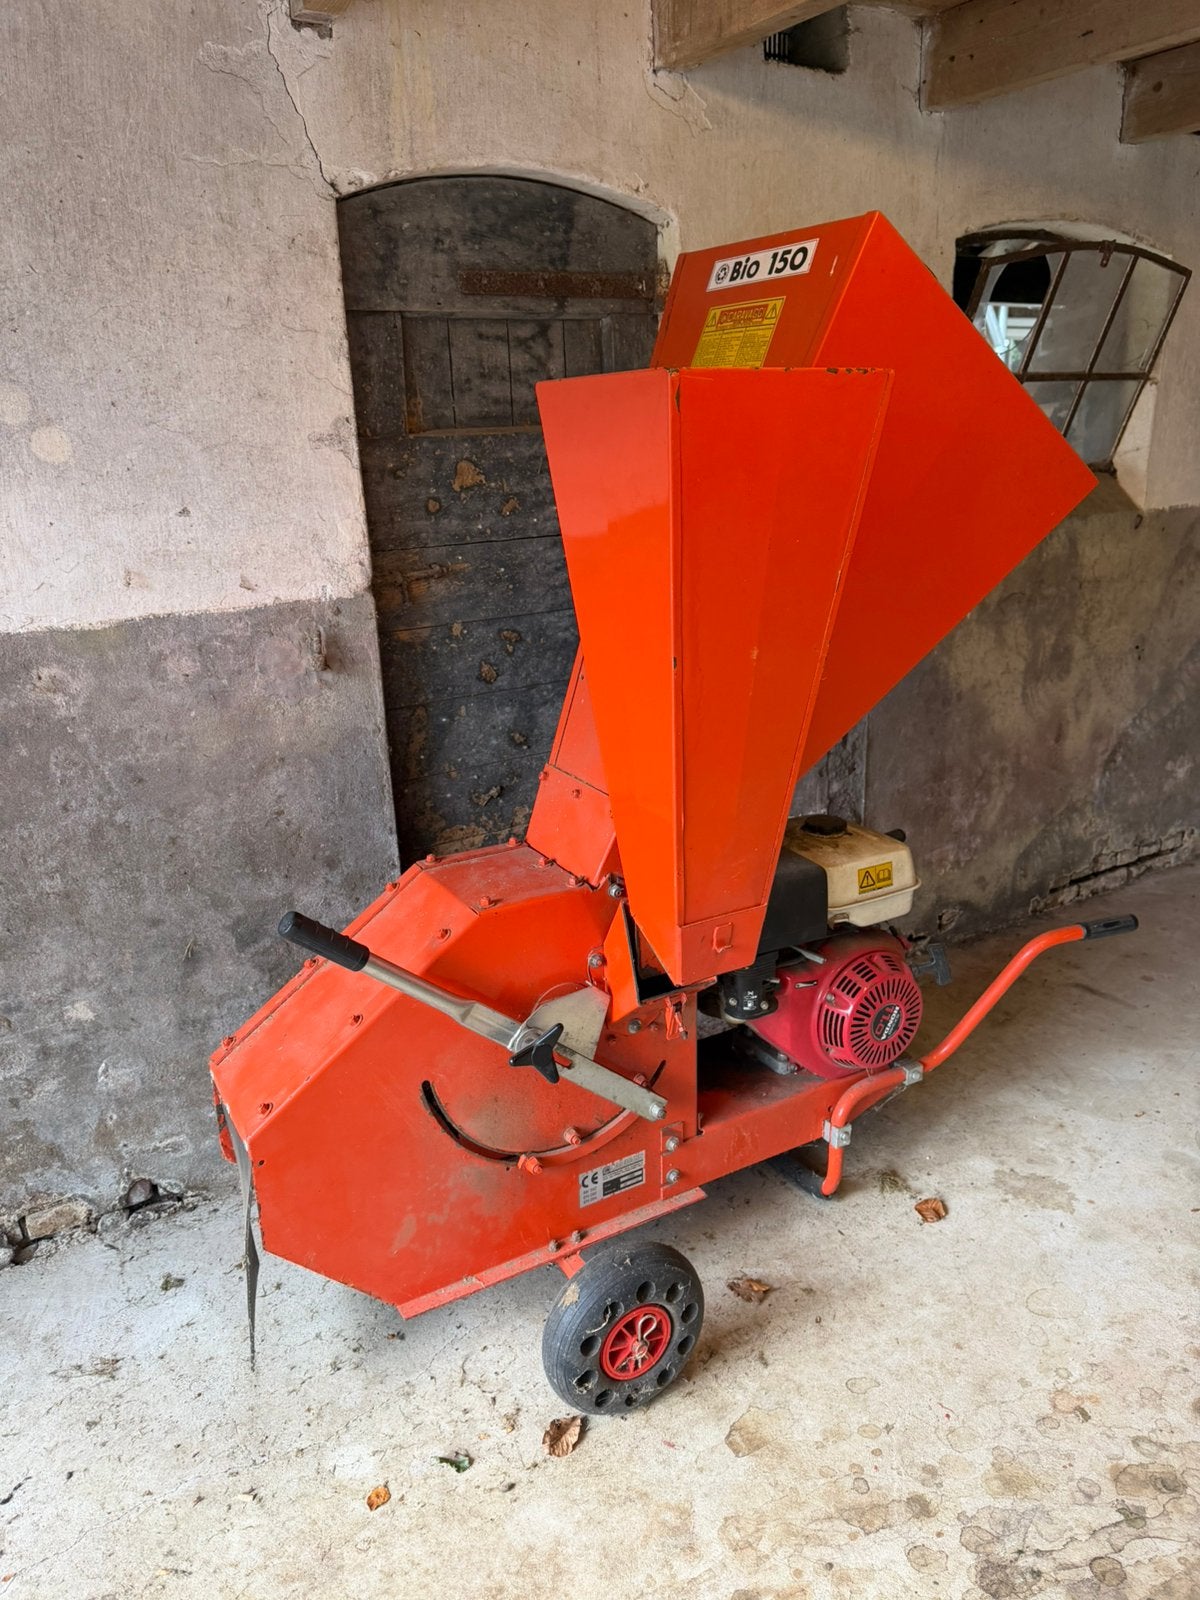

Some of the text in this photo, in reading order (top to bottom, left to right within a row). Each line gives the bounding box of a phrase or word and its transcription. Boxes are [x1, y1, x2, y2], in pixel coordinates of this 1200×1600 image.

[729, 246, 809, 282] Bio 150
[881, 1006, 899, 1040] HONDA
[582, 1172, 598, 1188] CE
